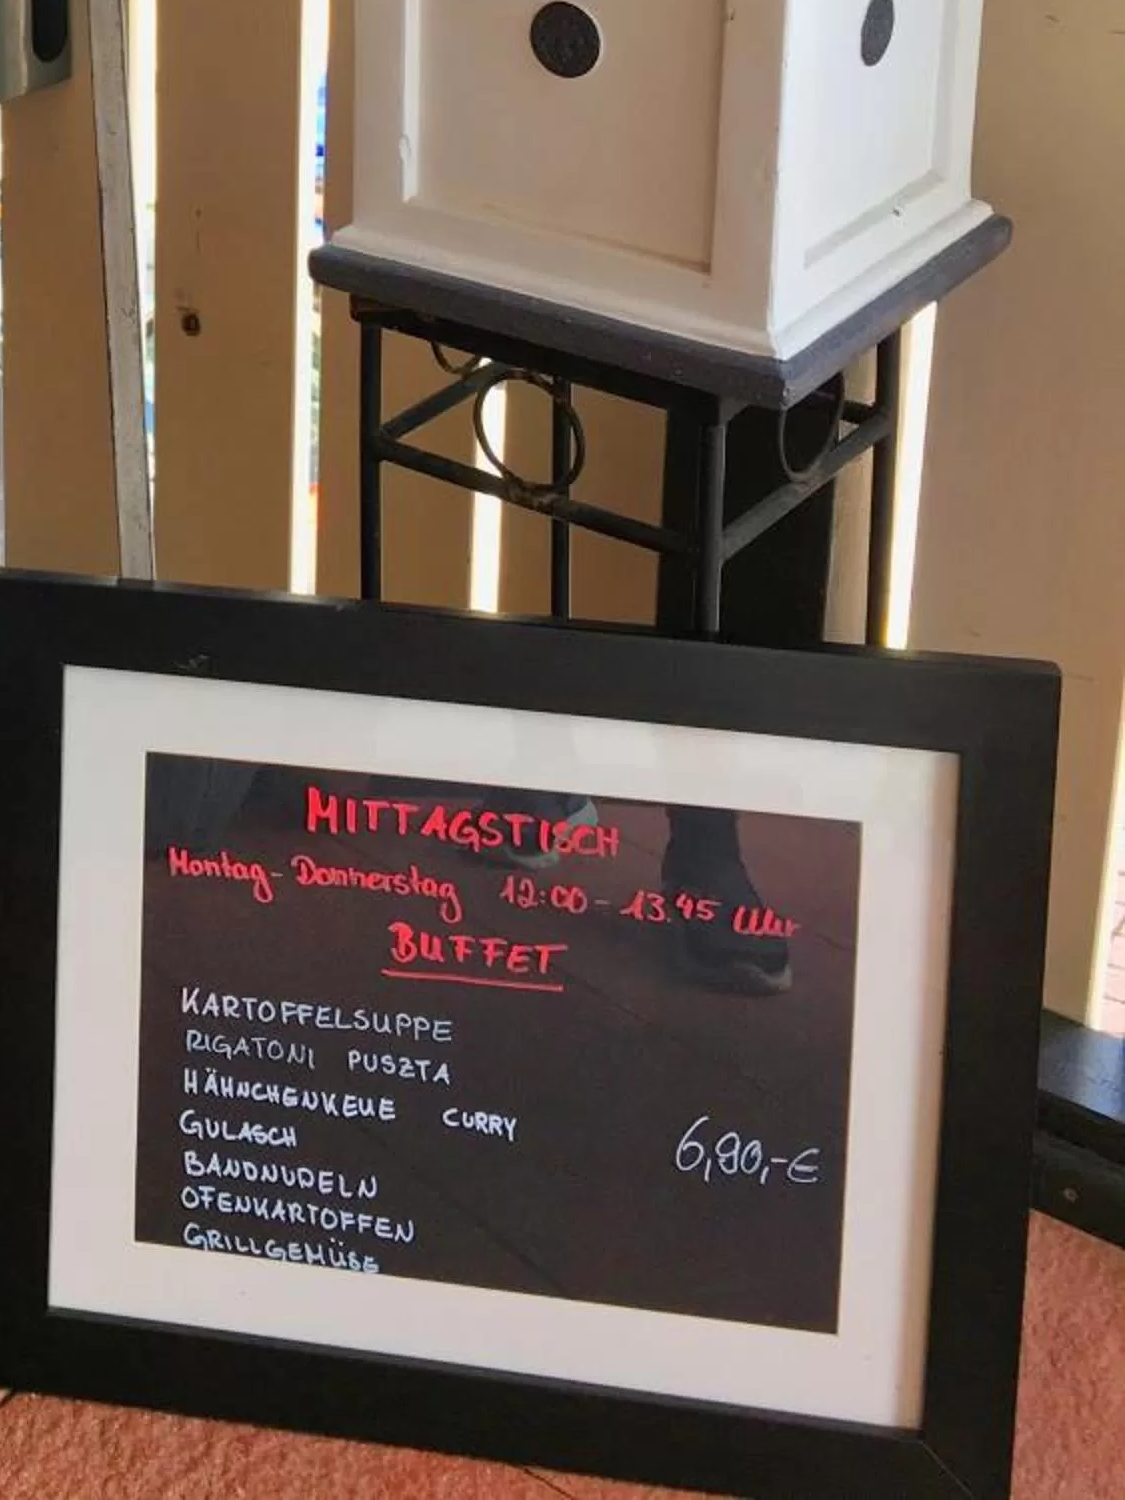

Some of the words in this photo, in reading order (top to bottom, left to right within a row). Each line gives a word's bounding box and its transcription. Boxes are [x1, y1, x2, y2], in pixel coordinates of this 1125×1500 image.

[305, 786, 620, 858] MITTAGSTISCH
[291, 855, 463, 924] Donnerstag
[499, 875, 587, 913] 12:00
[733, 903, 802, 937] Uhr
[388, 922, 568, 974] BUFFET
[181, 987, 454, 1041] KARTOFFELSUPPE
[186, 1029, 316, 1070] RIGATONI
[347, 1050, 451, 1086] PUSZTA
[179, 1109, 298, 1147] GULASCH
[442, 1107, 518, 1142] CURRY
[184, 1150, 378, 1199] BANDNUDELN
